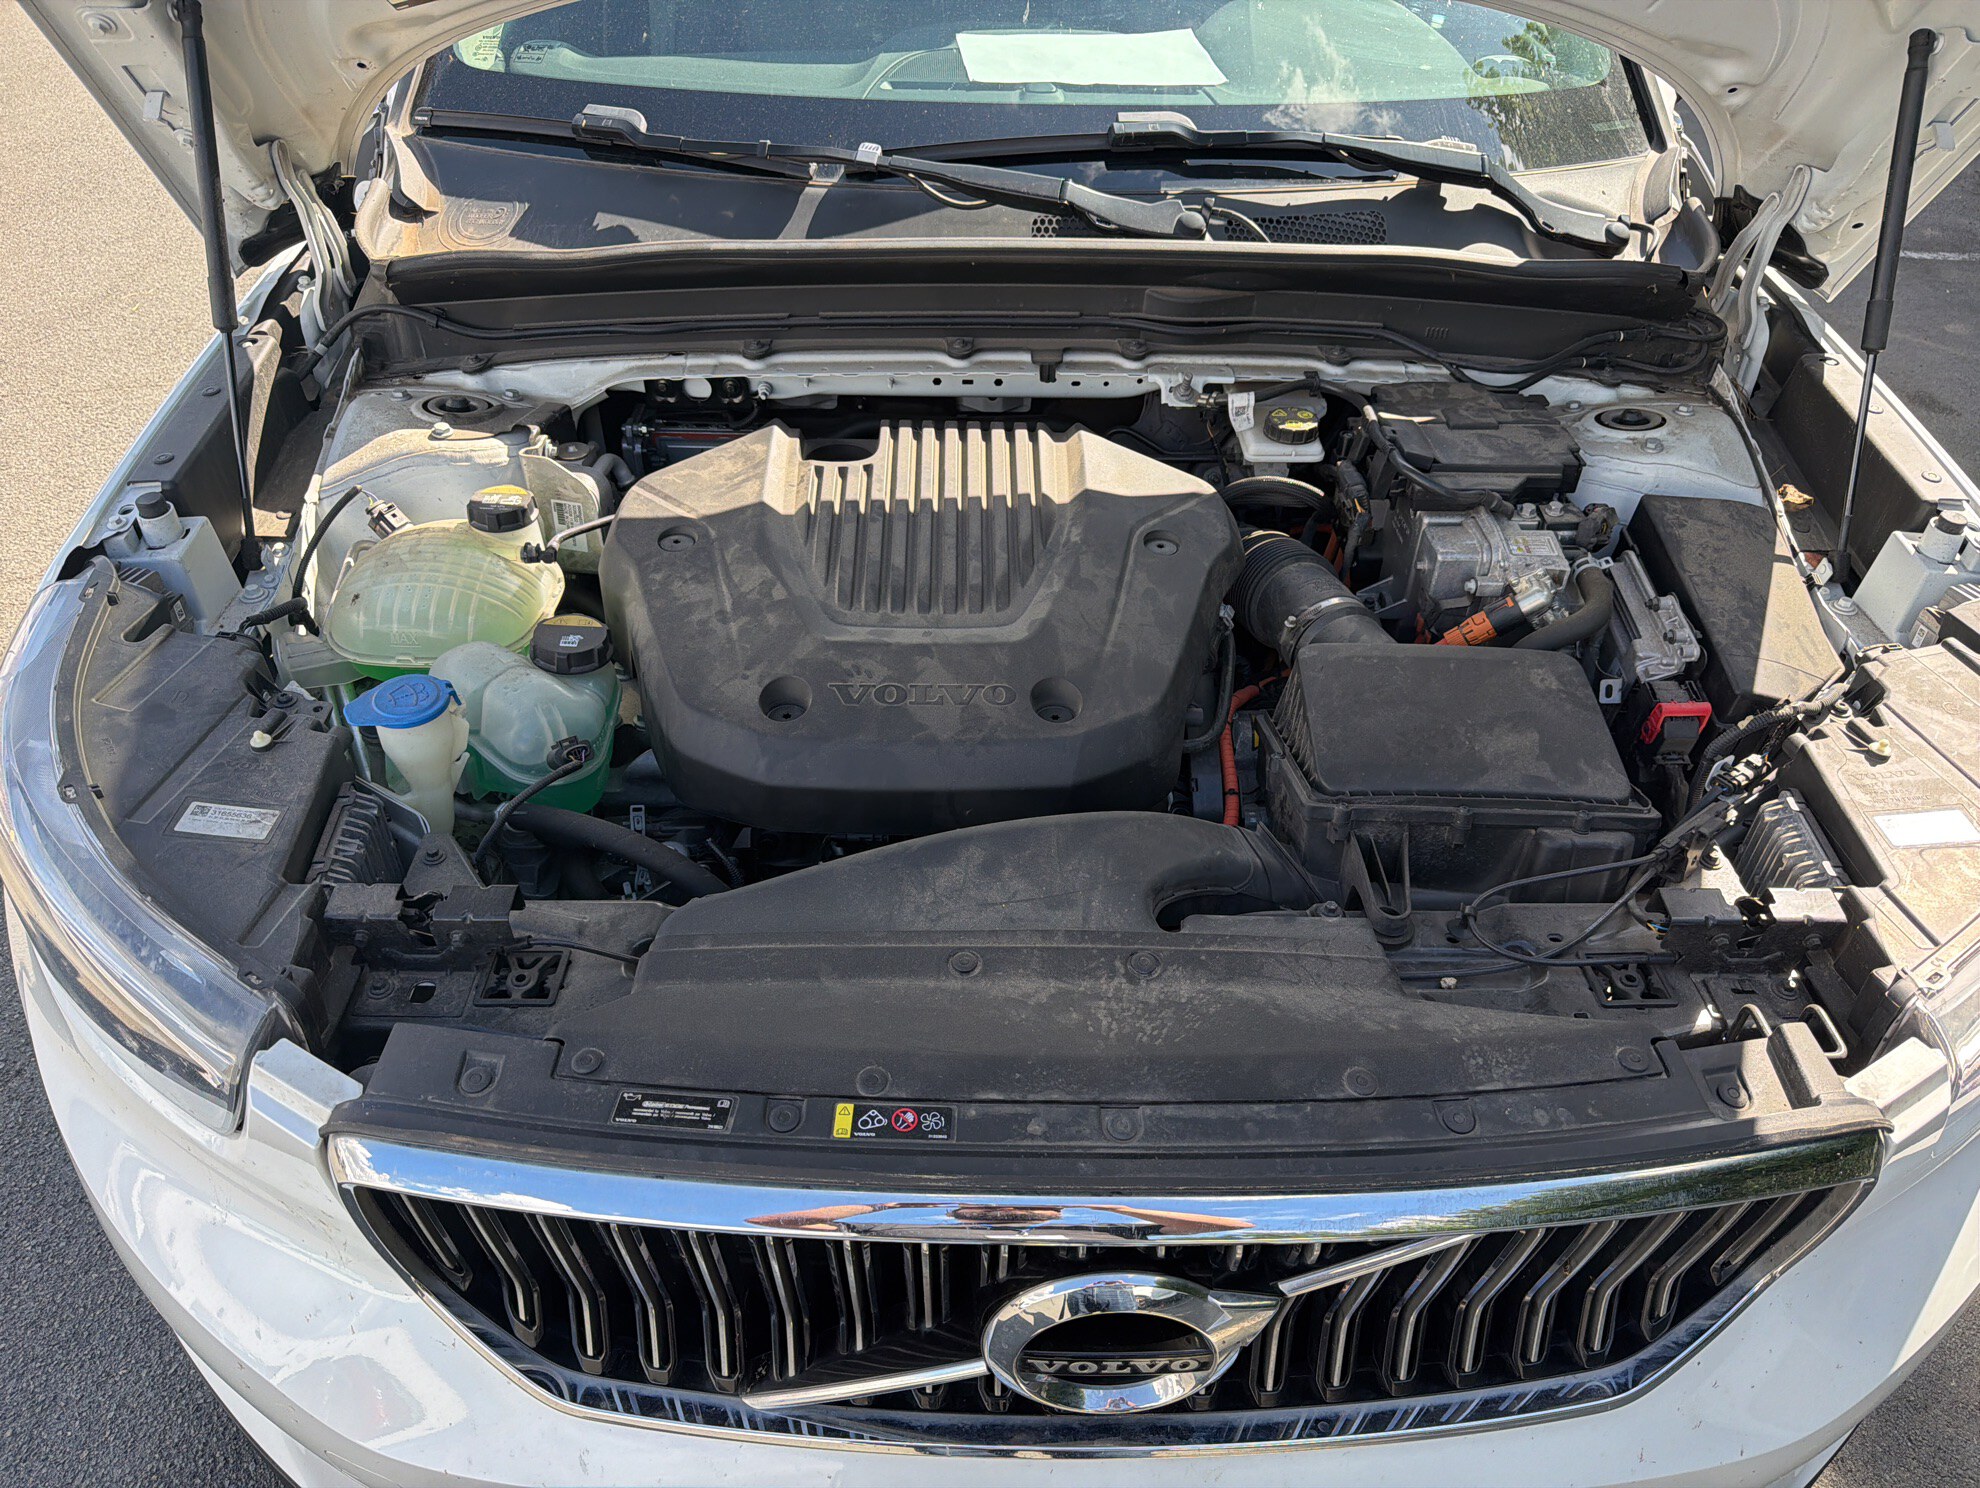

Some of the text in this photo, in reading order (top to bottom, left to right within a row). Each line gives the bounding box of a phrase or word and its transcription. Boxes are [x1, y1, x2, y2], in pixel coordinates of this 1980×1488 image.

[390, 631, 418, 645] MAX
[827, 682, 1017, 706] VOLVO
[1027, 1359, 1199, 1374] VOLVO
